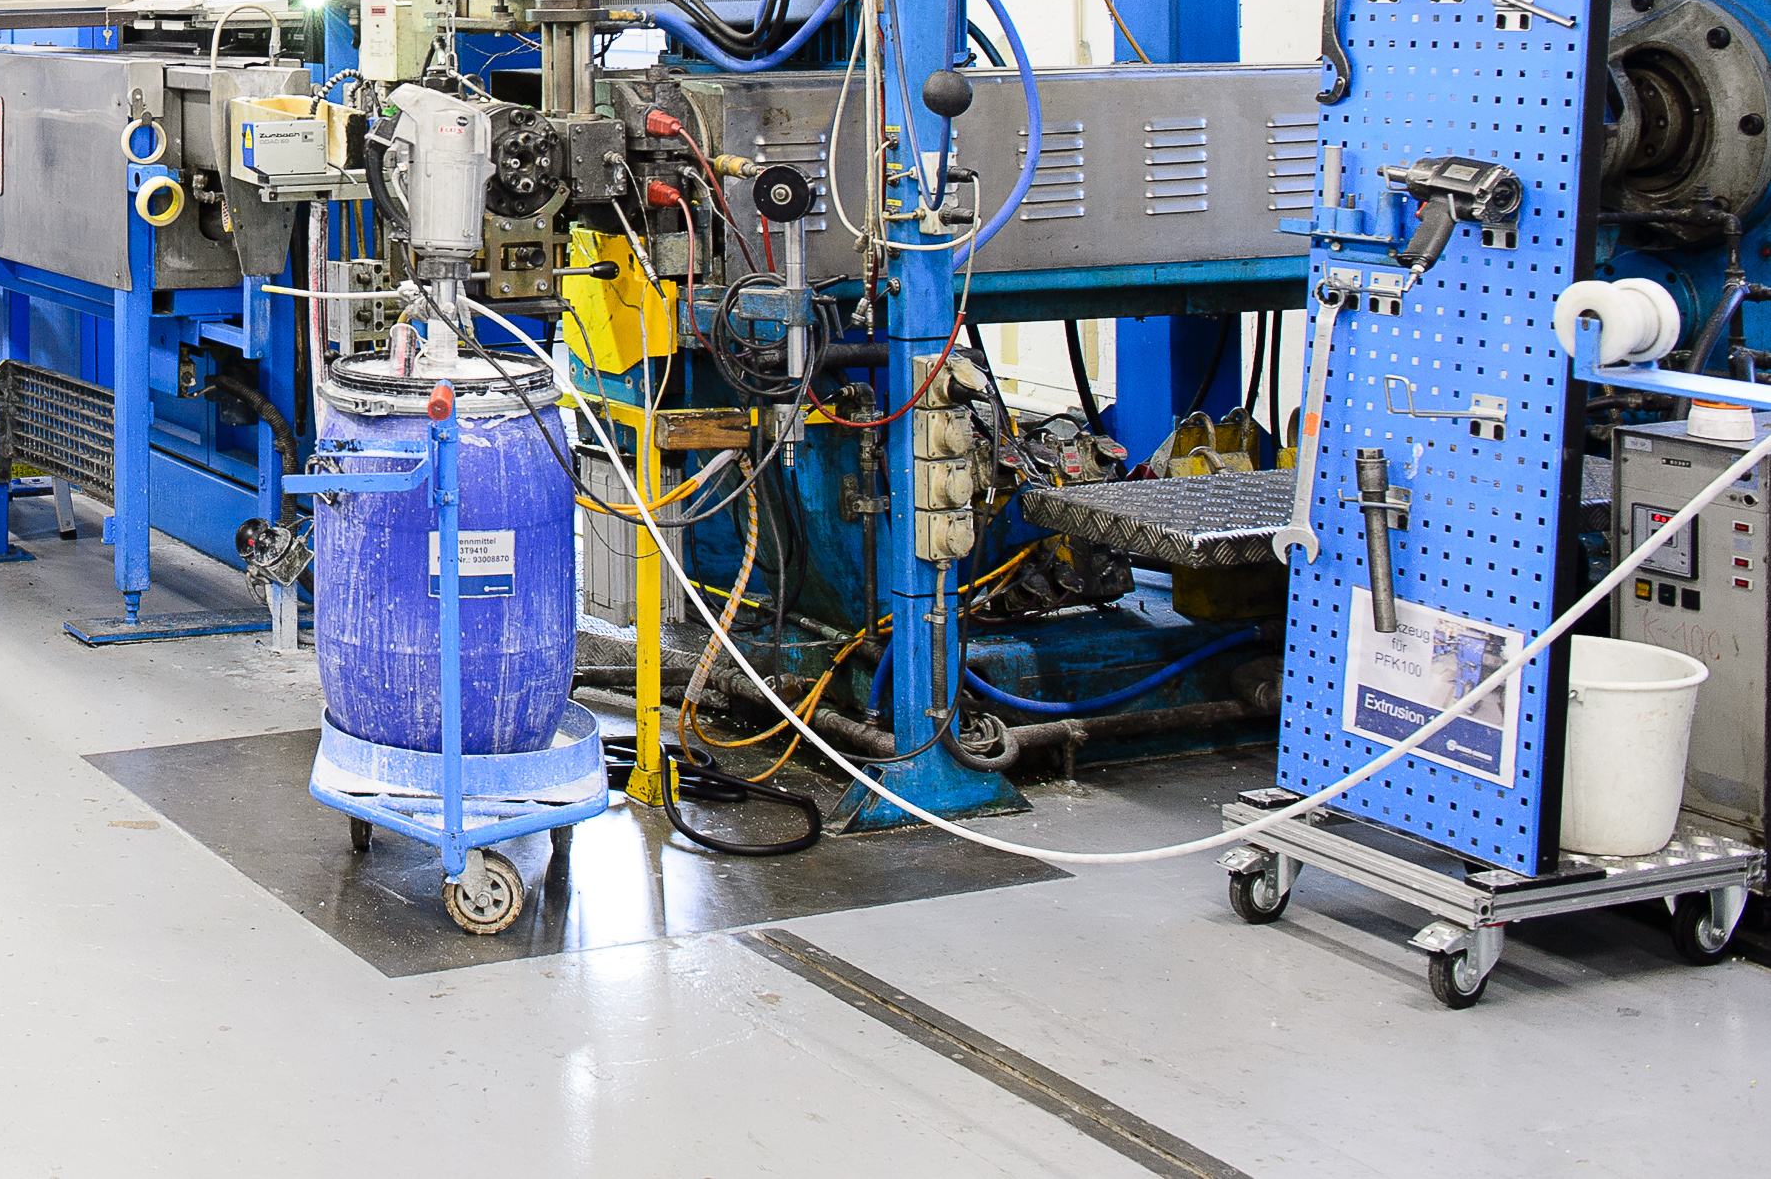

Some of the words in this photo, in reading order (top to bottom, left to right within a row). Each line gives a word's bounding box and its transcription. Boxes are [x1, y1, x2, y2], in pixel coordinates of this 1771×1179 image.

[458, 537, 496, 545] ennmittel
[472, 555, 509, 563] 93008870
[1395, 622, 1430, 643] kzeug
[1391, 637, 1408, 653] für
[1374, 651, 1423, 678] PFK100
[1364, 693, 1425, 726] Extrusion
